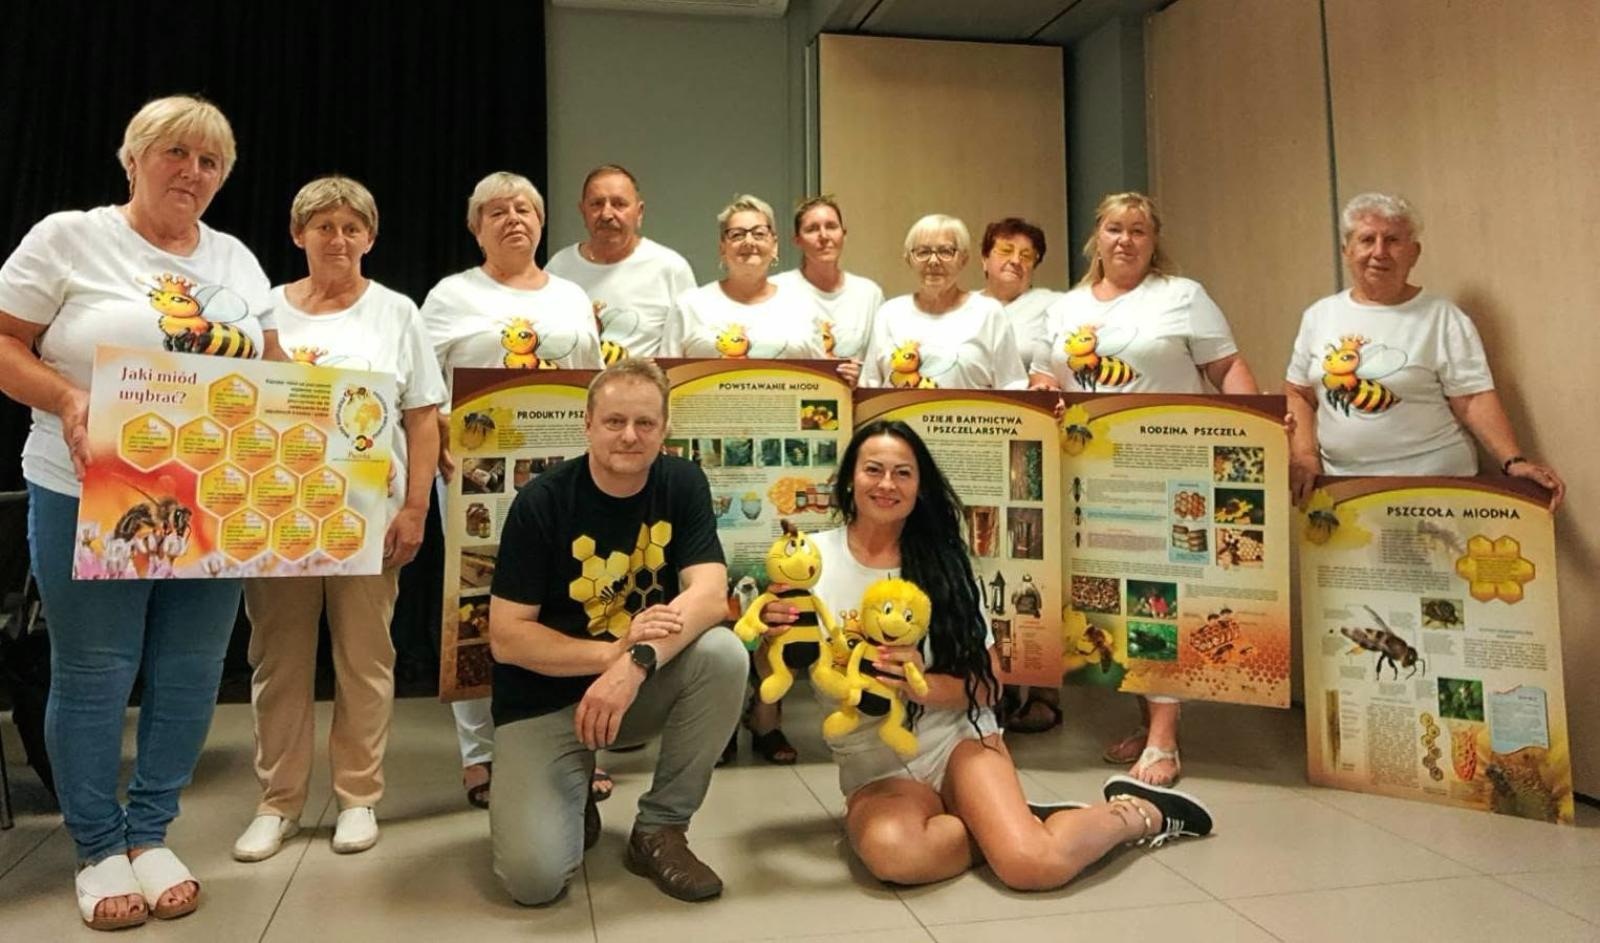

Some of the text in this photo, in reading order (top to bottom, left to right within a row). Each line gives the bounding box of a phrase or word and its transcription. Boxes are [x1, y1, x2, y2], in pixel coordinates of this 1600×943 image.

[121, 366, 197, 385] Jaki miód
[119, 388, 187, 404] wybrać?
[517, 411, 585, 419] PRODUKTY PSZ
[922, 415, 1022, 425] DZIEJE BARTNICTWA
[933, 426, 1018, 435] PSZCZELARSTWA
[1140, 426, 1247, 437] RODZINA PSZCZELA
[1387, 506, 1520, 519] PSZCZOŁA MIODNA
